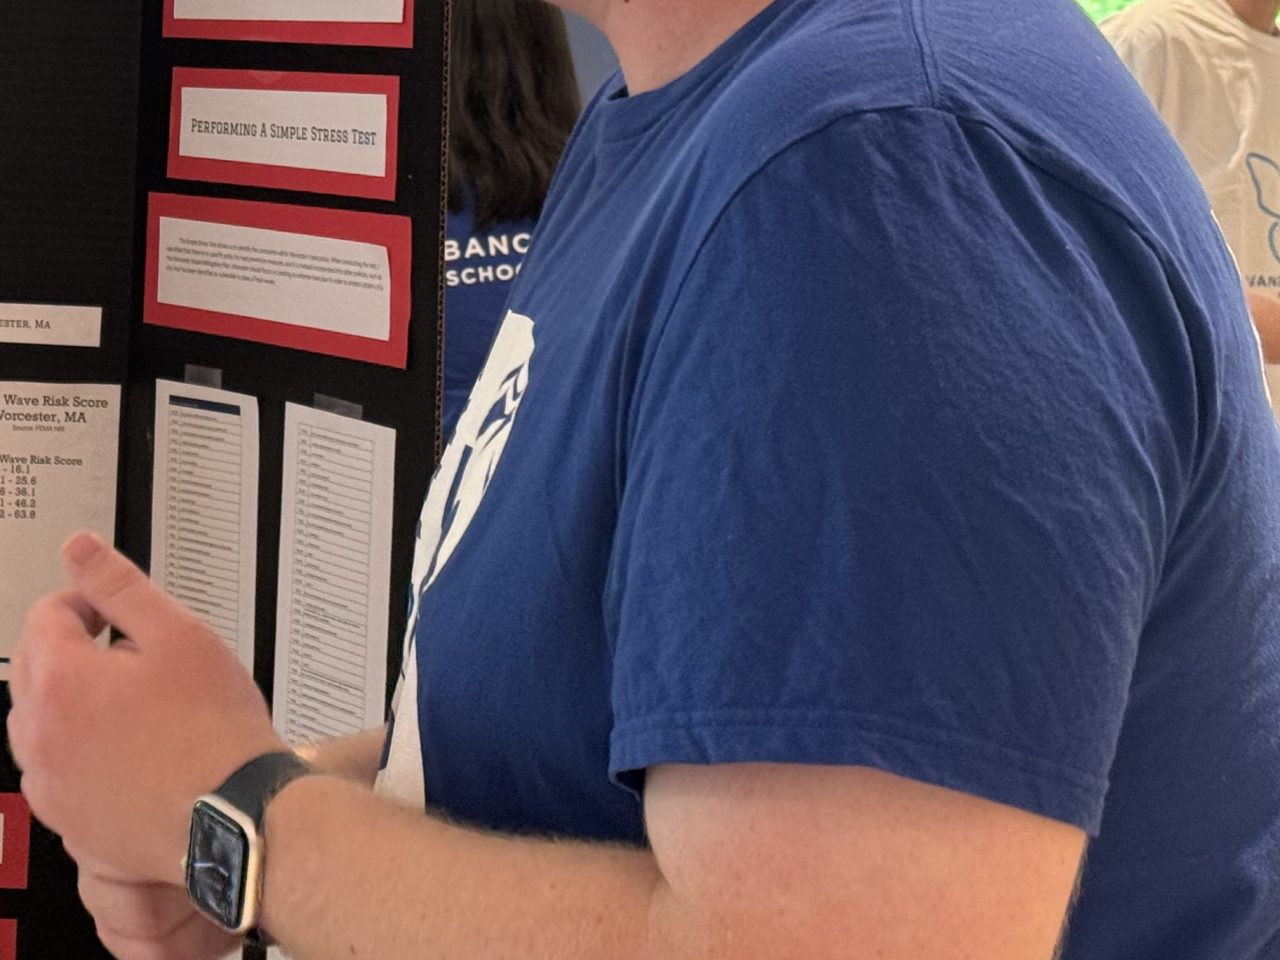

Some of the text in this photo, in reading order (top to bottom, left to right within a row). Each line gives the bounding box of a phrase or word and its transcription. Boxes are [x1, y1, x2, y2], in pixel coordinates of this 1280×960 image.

[191, 118, 376, 146] PERFORMING A SIMPLE STRESS TEST
[446, 262, 521, 287] SCHO
[1245, 275, 1280, 287] VAN
[35, 319, 51, 330] MA
[4, 394, 39, 406] Wave
[42, 395, 70, 407] Risk
[73, 396, 108, 408] Score
[64, 411, 87, 423] MA
[30, 455, 52, 465] Risk
[54, 456, 83, 466] Score
